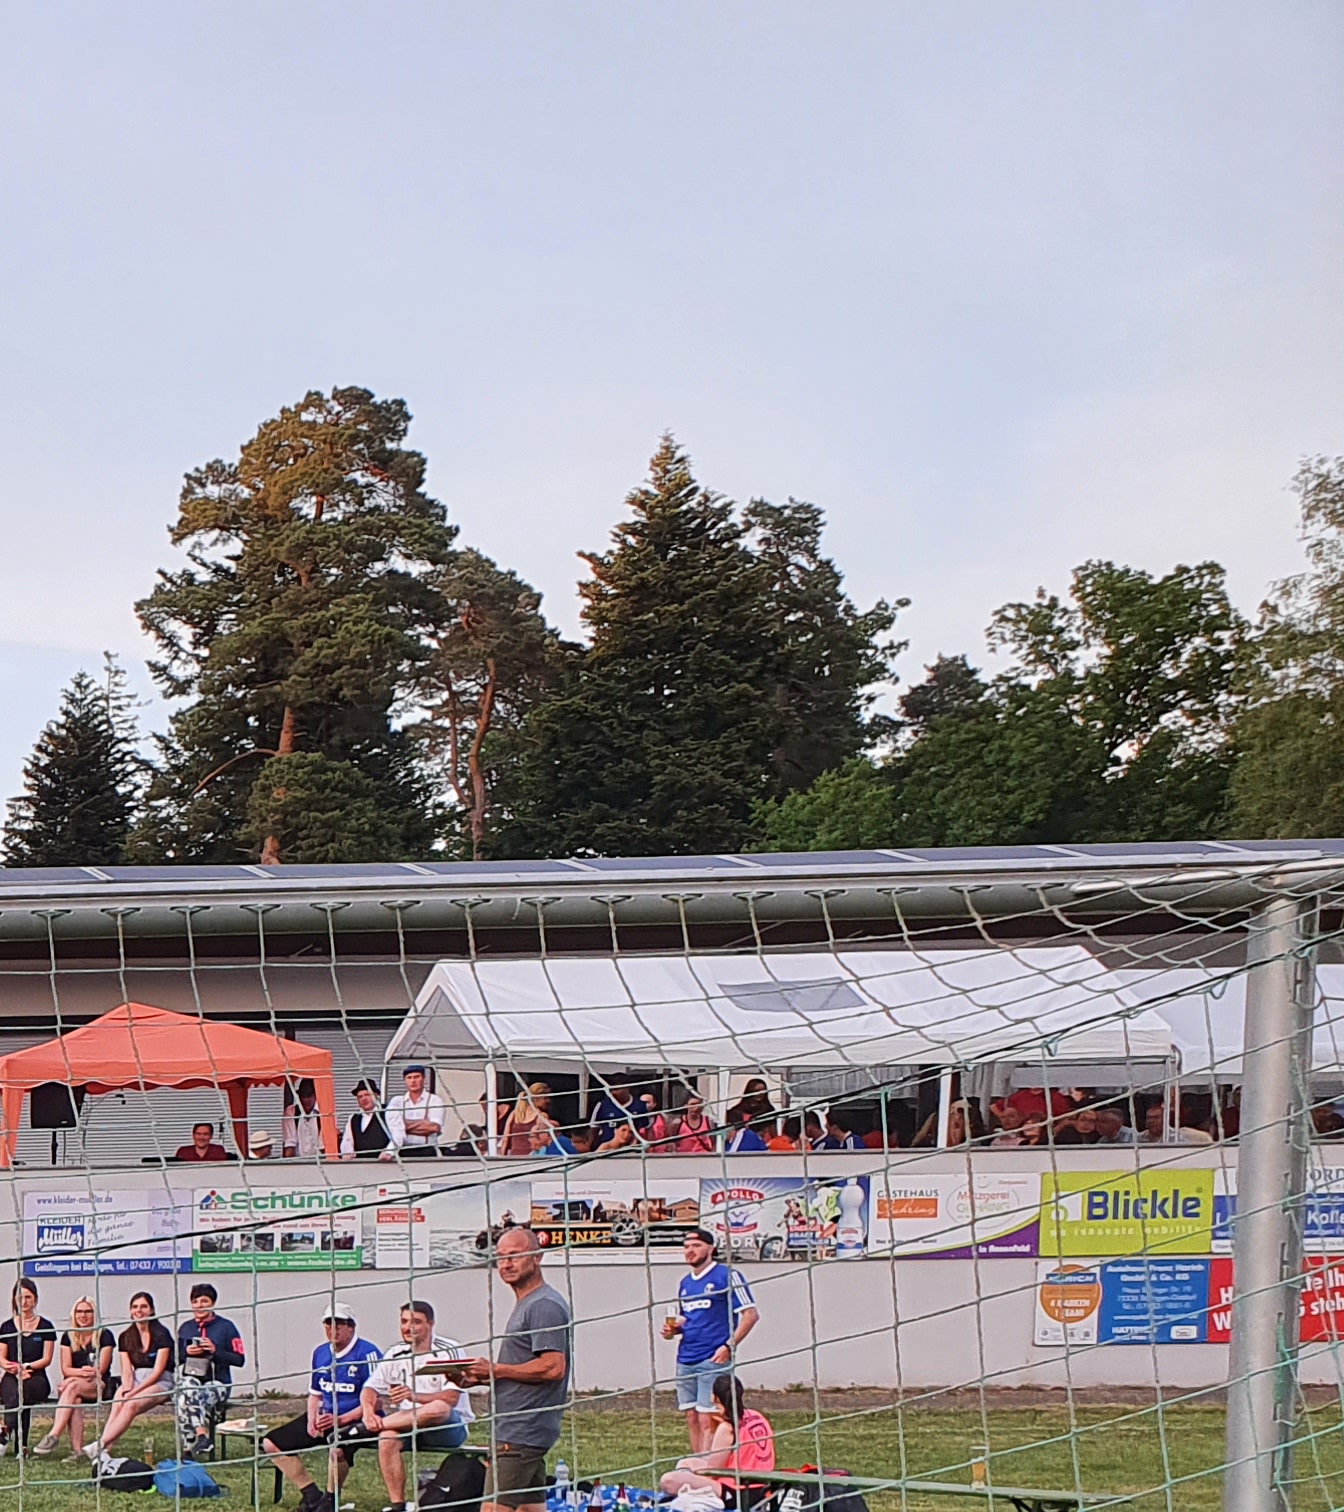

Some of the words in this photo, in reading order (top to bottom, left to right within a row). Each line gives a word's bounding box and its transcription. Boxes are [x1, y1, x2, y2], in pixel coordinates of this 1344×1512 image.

[37, 1195, 113, 1205] www.kleider-muller.de
[230, 1190, 357, 1210] Schünke
[877, 1189, 939, 1198] GSTEHAUS
[957, 1191, 1010, 1203] Mtzgerei
[1087, 1189, 1201, 1221] Blickle
[38, 1227, 82, 1248] Müller
[550, 1230, 612, 1245] HENKE
[83, 1262, 115, 1272] Balngen,
